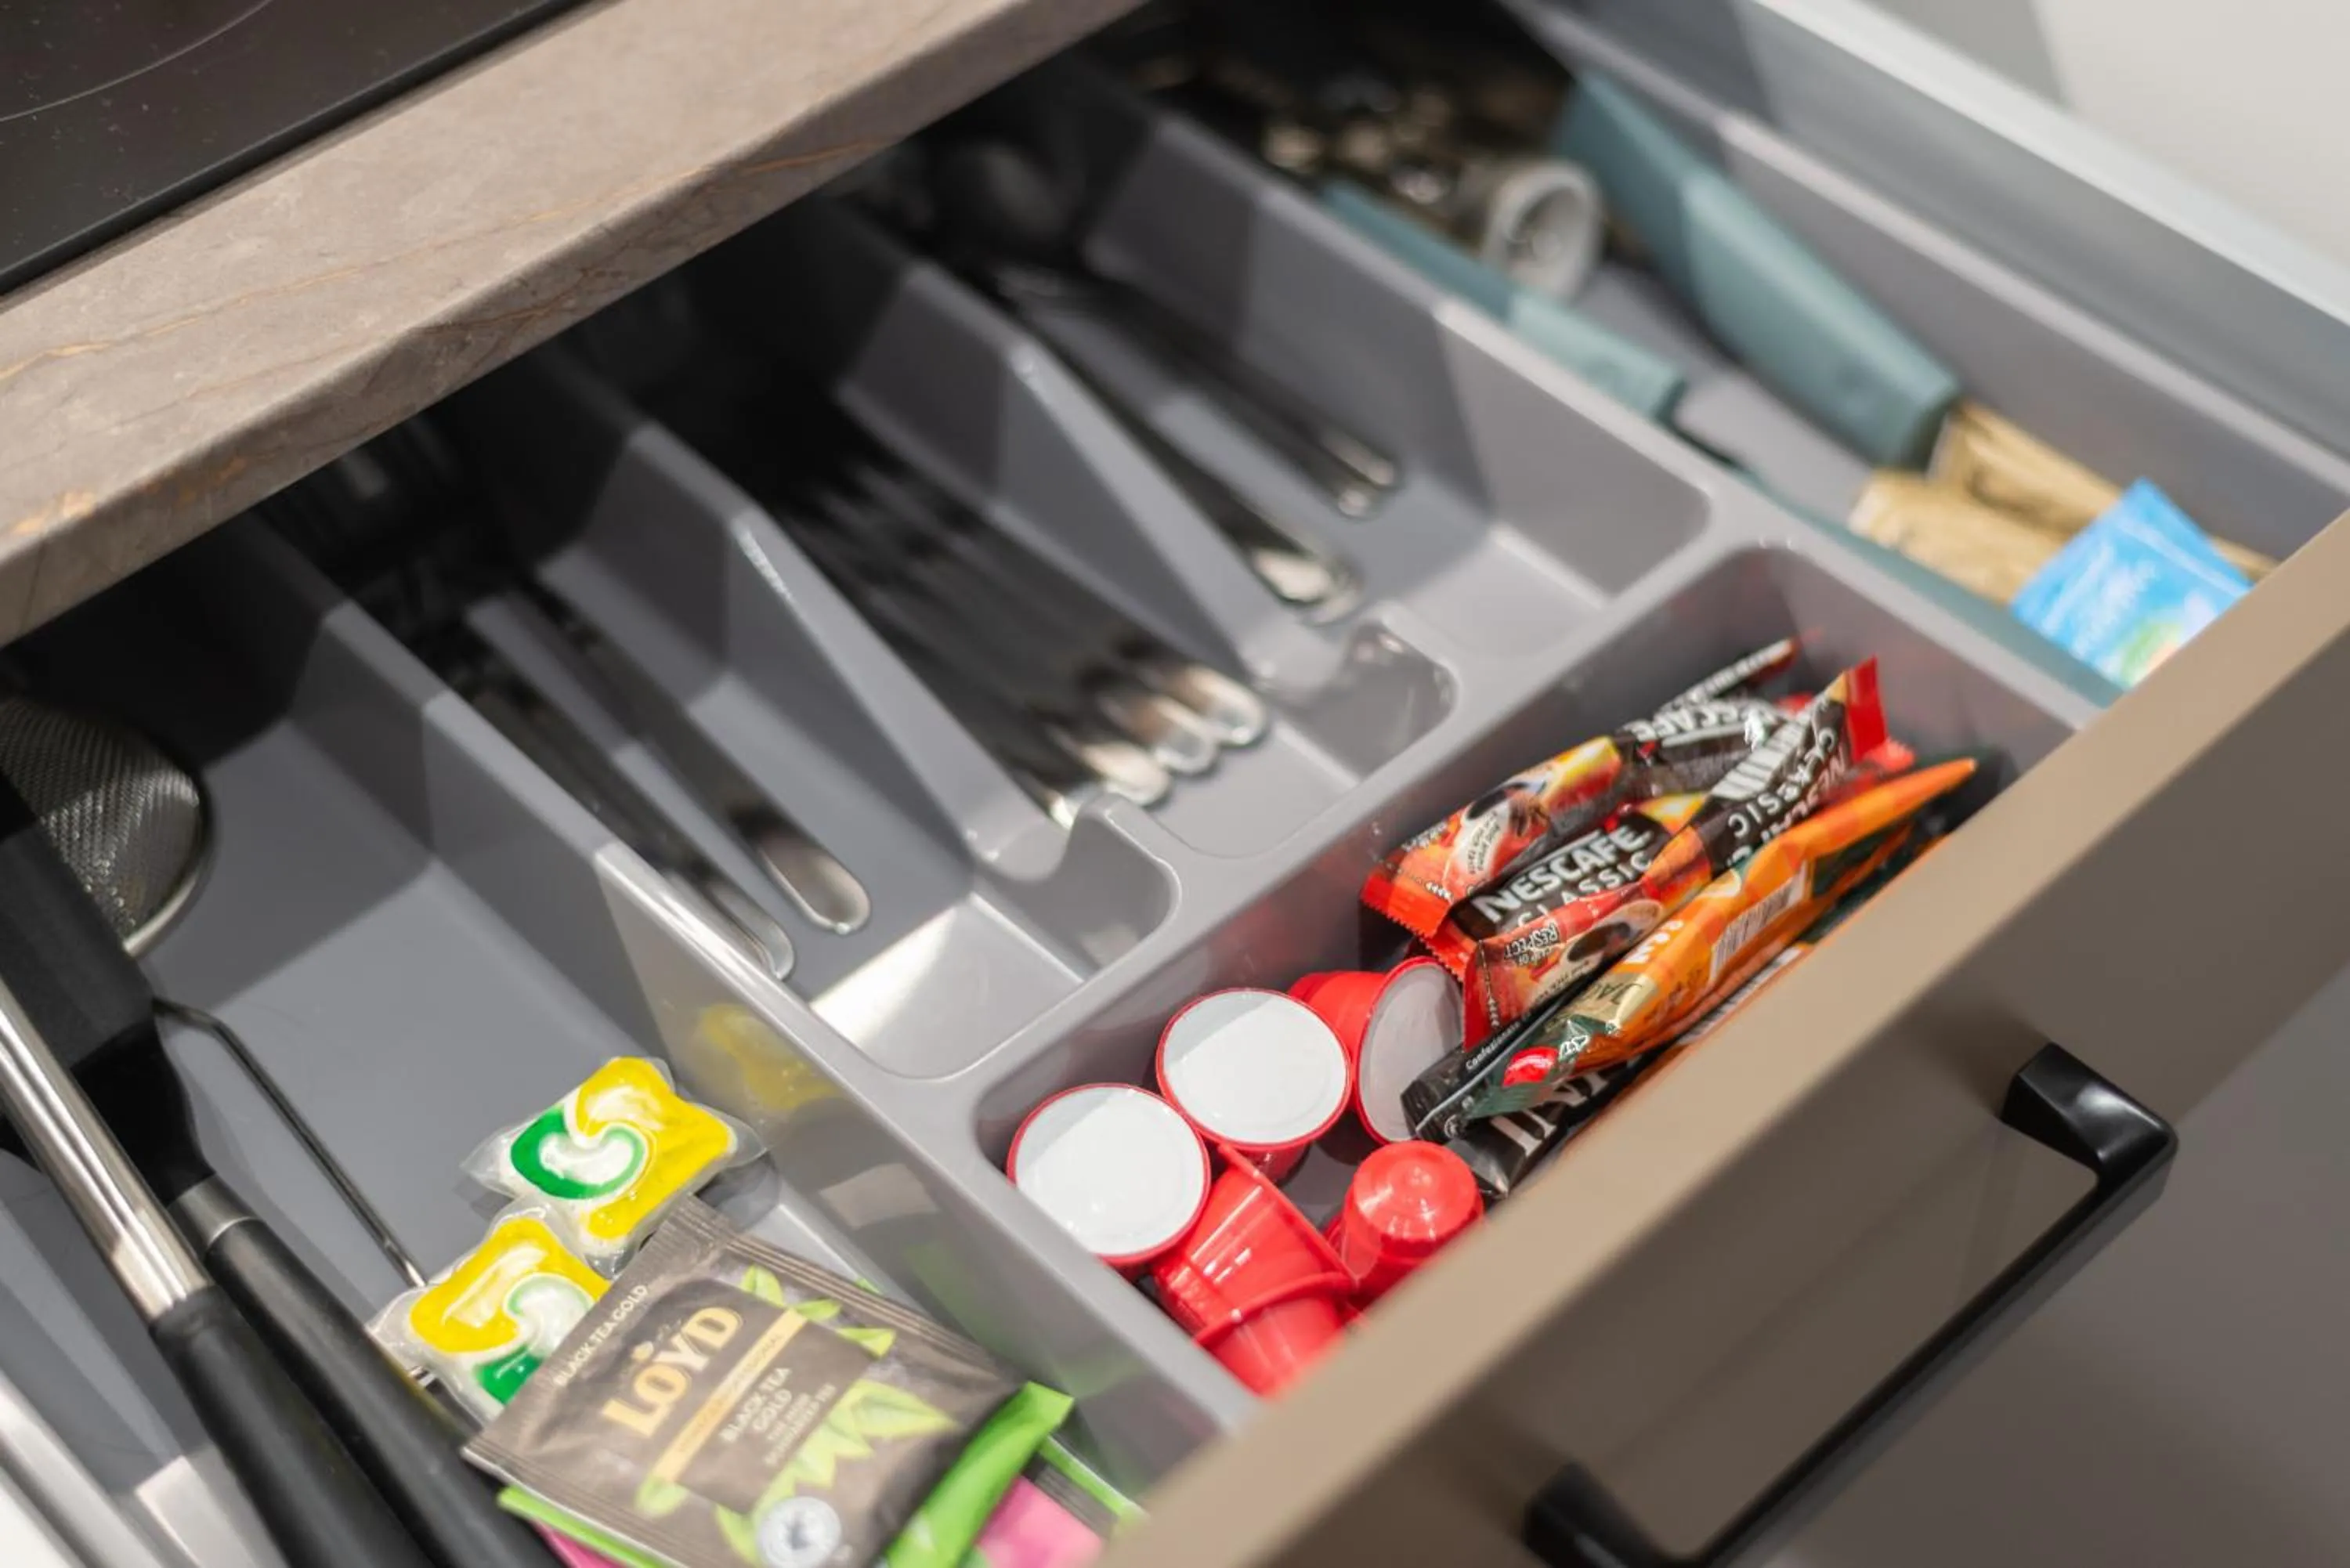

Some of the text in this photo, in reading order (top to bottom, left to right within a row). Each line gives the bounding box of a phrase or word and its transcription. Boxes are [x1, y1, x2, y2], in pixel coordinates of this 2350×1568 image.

[1505, 923, 1559, 960] RESPECT
[551, 1284, 649, 1388] BLACK TEA GOLD
[601, 1306, 743, 1439] LOYD
[718, 1367, 792, 1443] BLACK TEA
